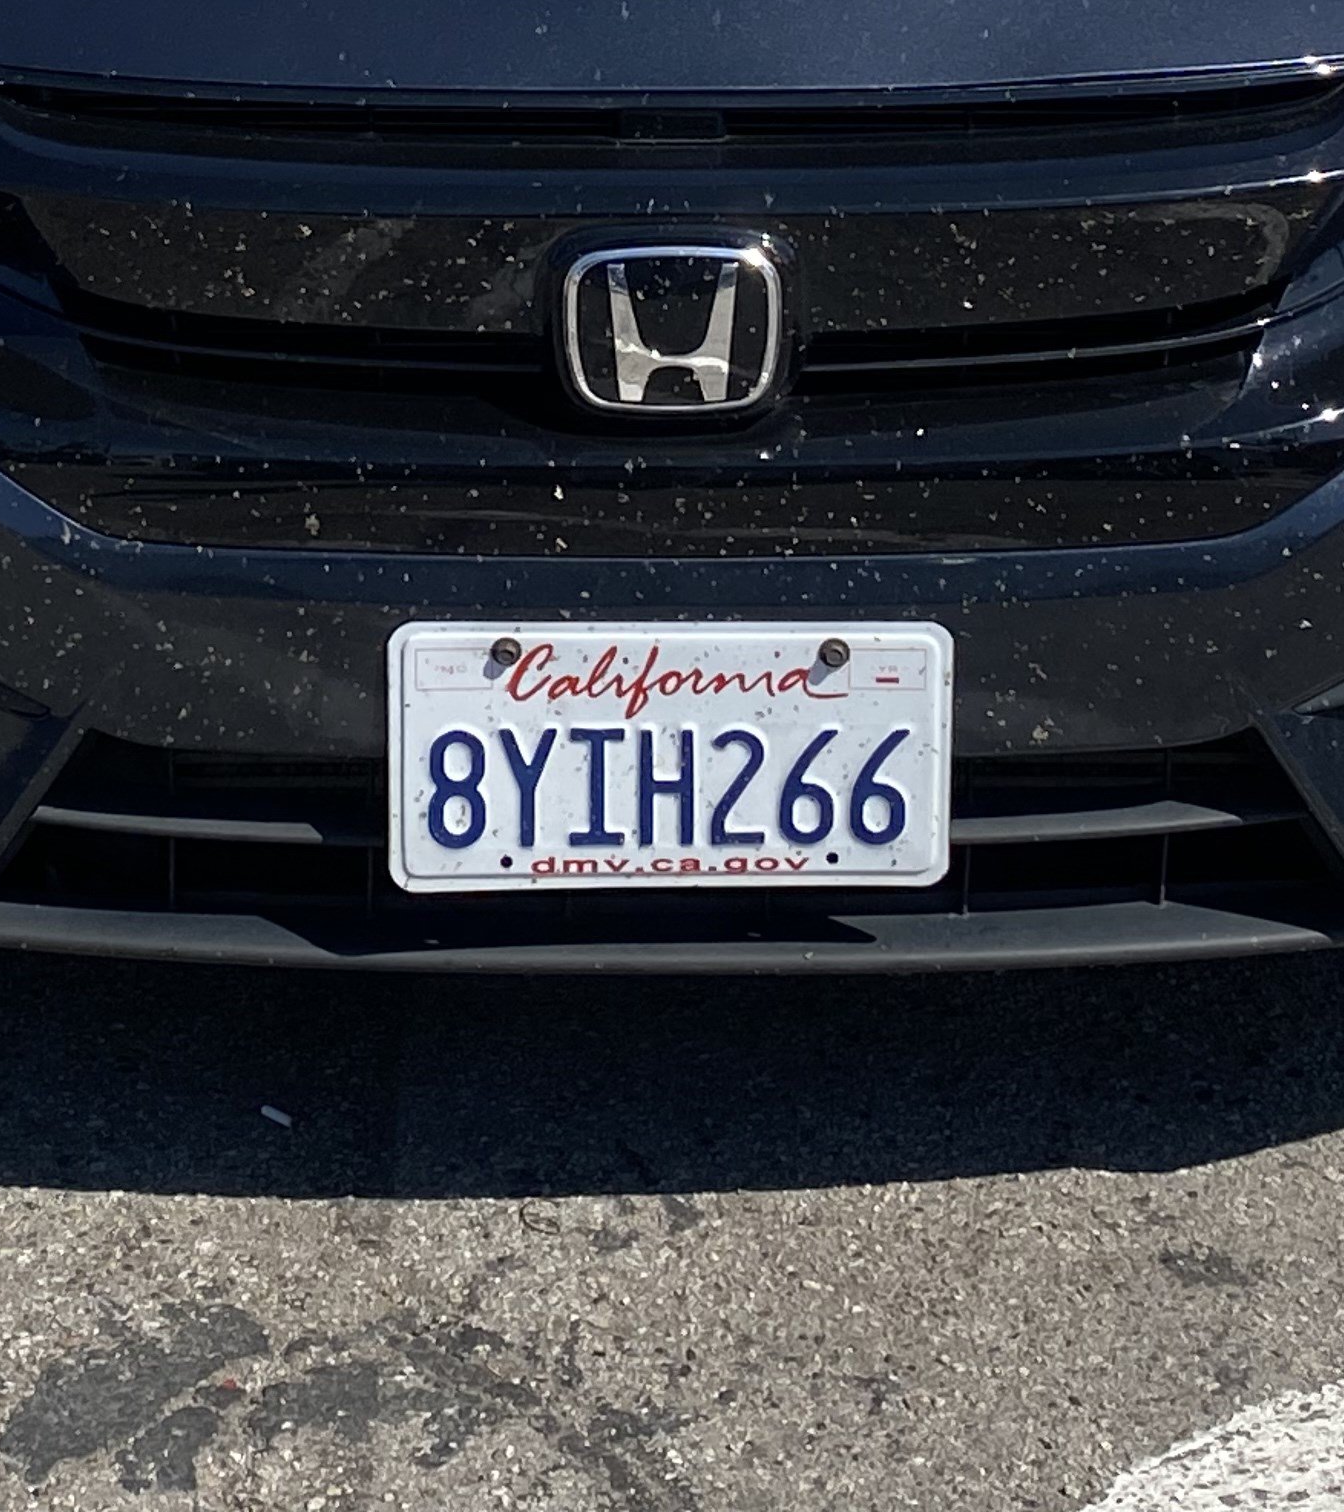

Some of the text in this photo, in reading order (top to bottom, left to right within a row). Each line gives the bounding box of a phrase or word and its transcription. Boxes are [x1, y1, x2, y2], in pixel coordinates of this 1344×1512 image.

[505, 643, 849, 720] California
[427, 727, 911, 850] 8YIH266
[530, 854, 810, 876] dmv.ca.gov
